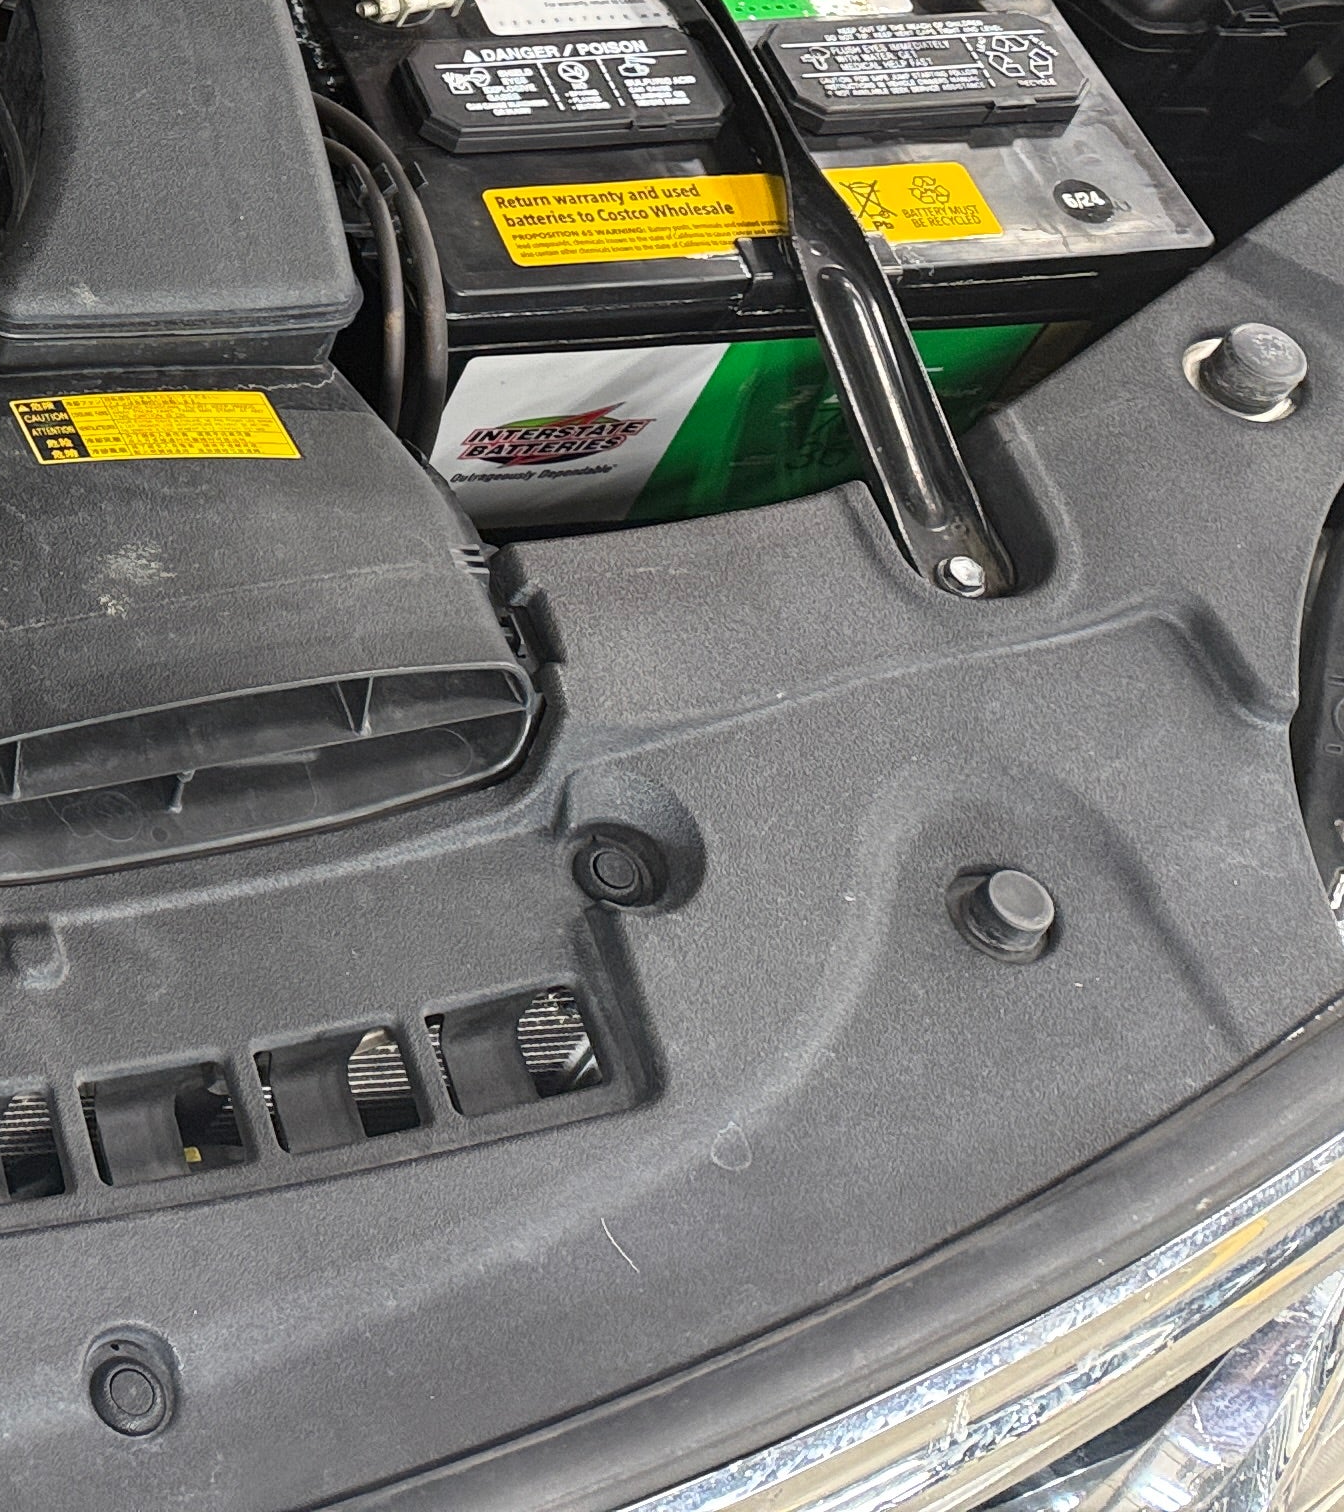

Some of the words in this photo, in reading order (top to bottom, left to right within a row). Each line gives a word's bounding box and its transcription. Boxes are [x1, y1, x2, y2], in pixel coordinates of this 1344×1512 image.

[480, 46, 560, 61] DANGER
[578, 40, 648, 55] POISON
[862, 43, 888, 53] EYES
[834, 54, 859, 64] WITH
[839, 61, 881, 71] MEDICAL
[882, 59, 908, 69] HELP
[911, 57, 934, 67] FAST
[495, 195, 552, 209] Return
[554, 191, 625, 207] warranty
[629, 187, 657, 202] and
[662, 184, 700, 199] used
[504, 211, 576, 228] batteries
[579, 212, 594, 223] to
[596, 207, 650, 222] Costco
[650, 201, 735, 218] Wholesale
[901, 206, 949, 218] BATTERY
[950, 204, 979, 216] MUST
[872, 219, 894, 232] Pb
[912, 218, 927, 228] BE
[928, 215, 982, 227] RECYCLED
[512, 231, 579, 241] PROPOSITION
[24, 412, 69, 423] CAUTION
[32, 425, 76, 436] ATTENTION
[468, 421, 643, 442] INTERSTATE
[467, 438, 621, 457] BATTERIES
[450, 470, 537, 483] Outrageously
